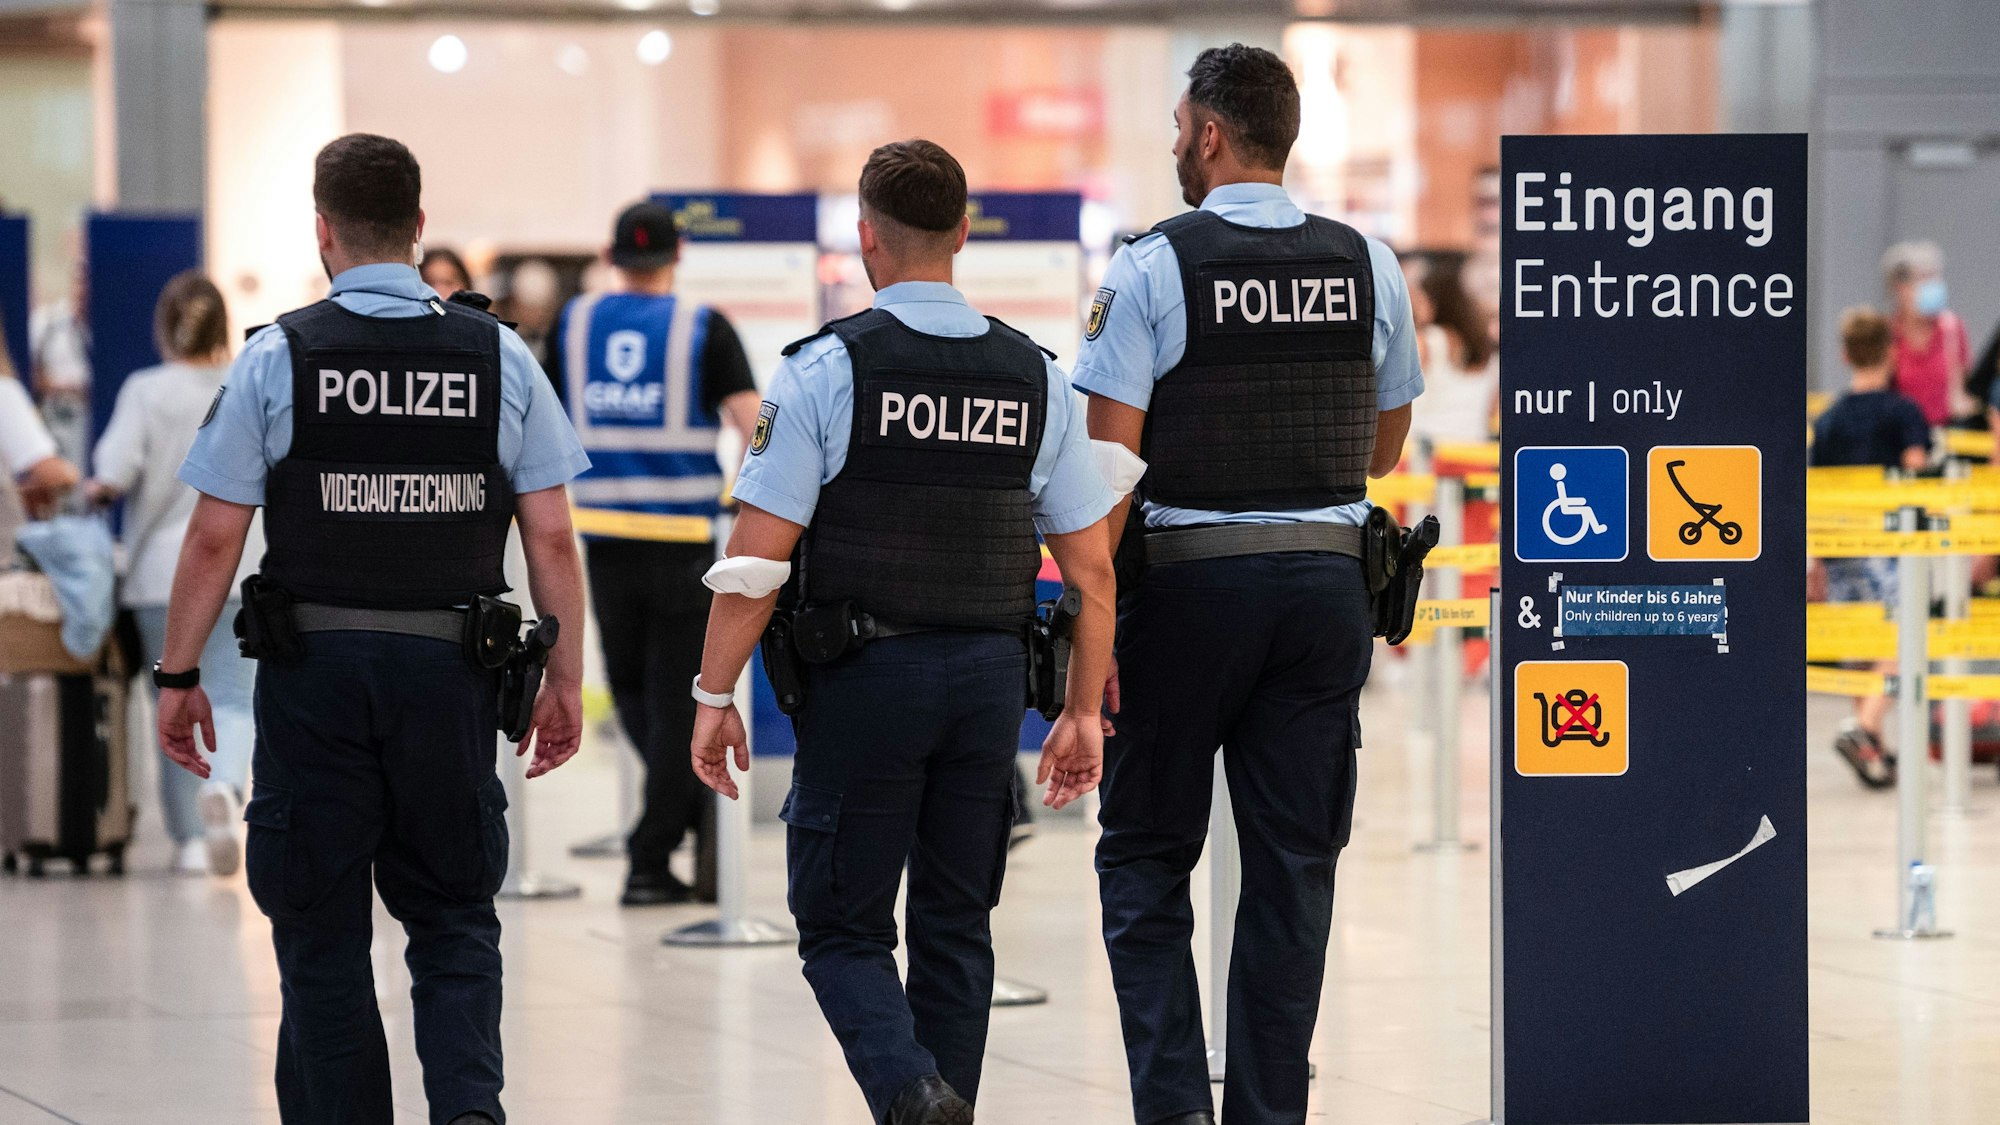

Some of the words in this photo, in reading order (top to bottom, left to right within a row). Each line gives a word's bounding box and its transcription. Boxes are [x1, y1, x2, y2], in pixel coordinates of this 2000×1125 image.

[1515, 172, 1773, 247] Eingang
[1214, 278, 1358, 323] POLIZEI
[1515, 259, 1794, 317] Entrance
[318, 369, 477, 418] POLIZEI
[1515, 389, 1572, 414] nur
[1612, 381, 1683, 420] only
[879, 391, 1029, 446] POLIZEI
[320, 472, 485, 513] VIDEOAUFZEICHNUNG
[1518, 595, 1541, 629] &
[1565, 590, 1592, 604] Nur
[1596, 590, 1643, 604] Kinder
[1647, 590, 1668, 604] bis
[1671, 591, 1680, 604] 6
[1683, 591, 1722, 605] Jahre
[1565, 610, 1592, 623] Only
[1594, 610, 1642, 622] children
[1645, 612, 1660, 624] up
[1663, 612, 1674, 622] to
[1677, 612, 1685, 622] 6
[1687, 613, 1718, 625] years
